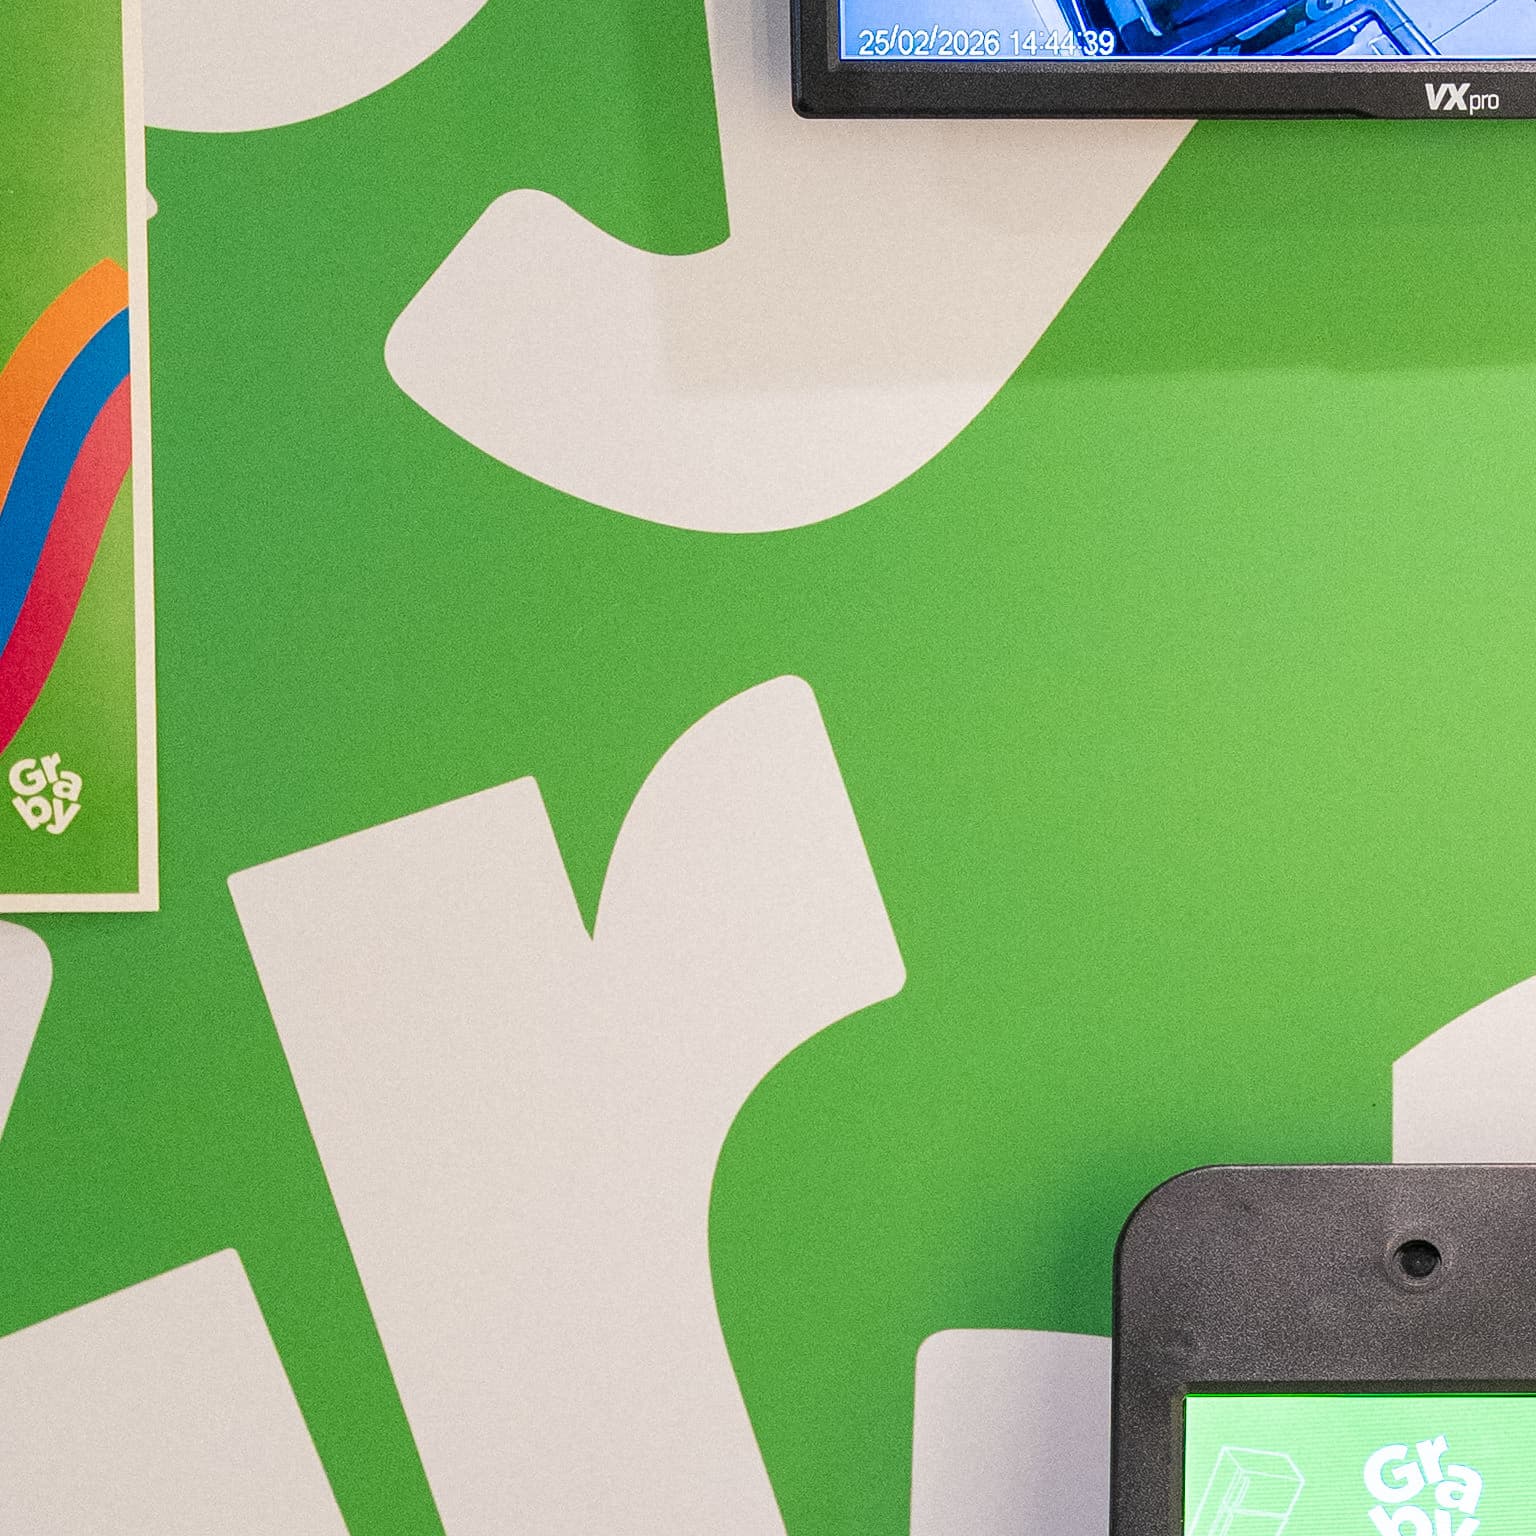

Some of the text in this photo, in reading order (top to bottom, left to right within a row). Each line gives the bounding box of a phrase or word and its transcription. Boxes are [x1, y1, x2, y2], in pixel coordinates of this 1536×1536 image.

[858, 24, 1115, 57] 25/02/2026 14:44:39
[8, 752, 83, 835] Graby
